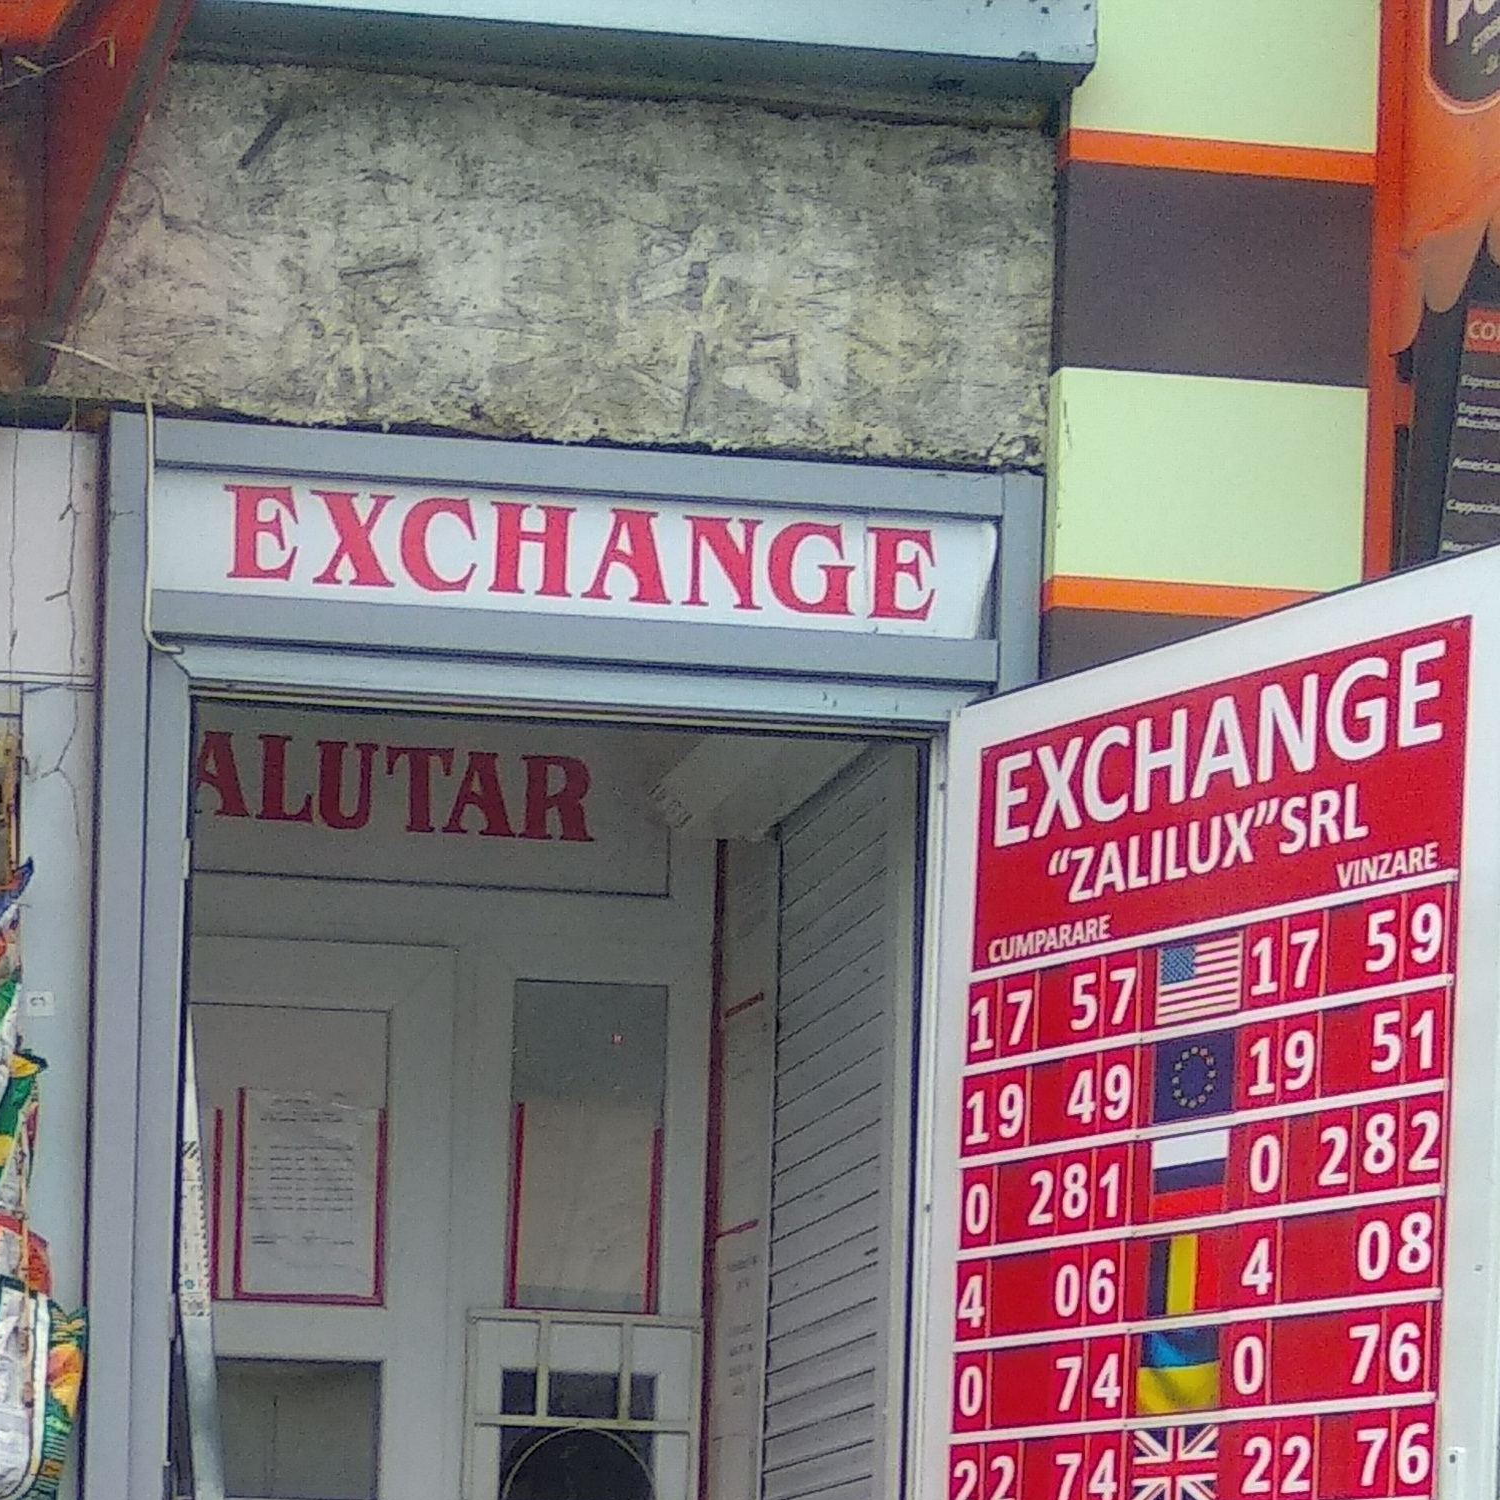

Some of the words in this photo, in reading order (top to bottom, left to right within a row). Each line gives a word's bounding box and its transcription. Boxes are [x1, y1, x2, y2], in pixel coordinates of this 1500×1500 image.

[222, 483, 936, 622] EXCHANGE
[993, 639, 1448, 848] EXCHANGE
[1336, 842, 1438, 888] VINZARE
[987, 914, 1111, 963] CUMPARARE
